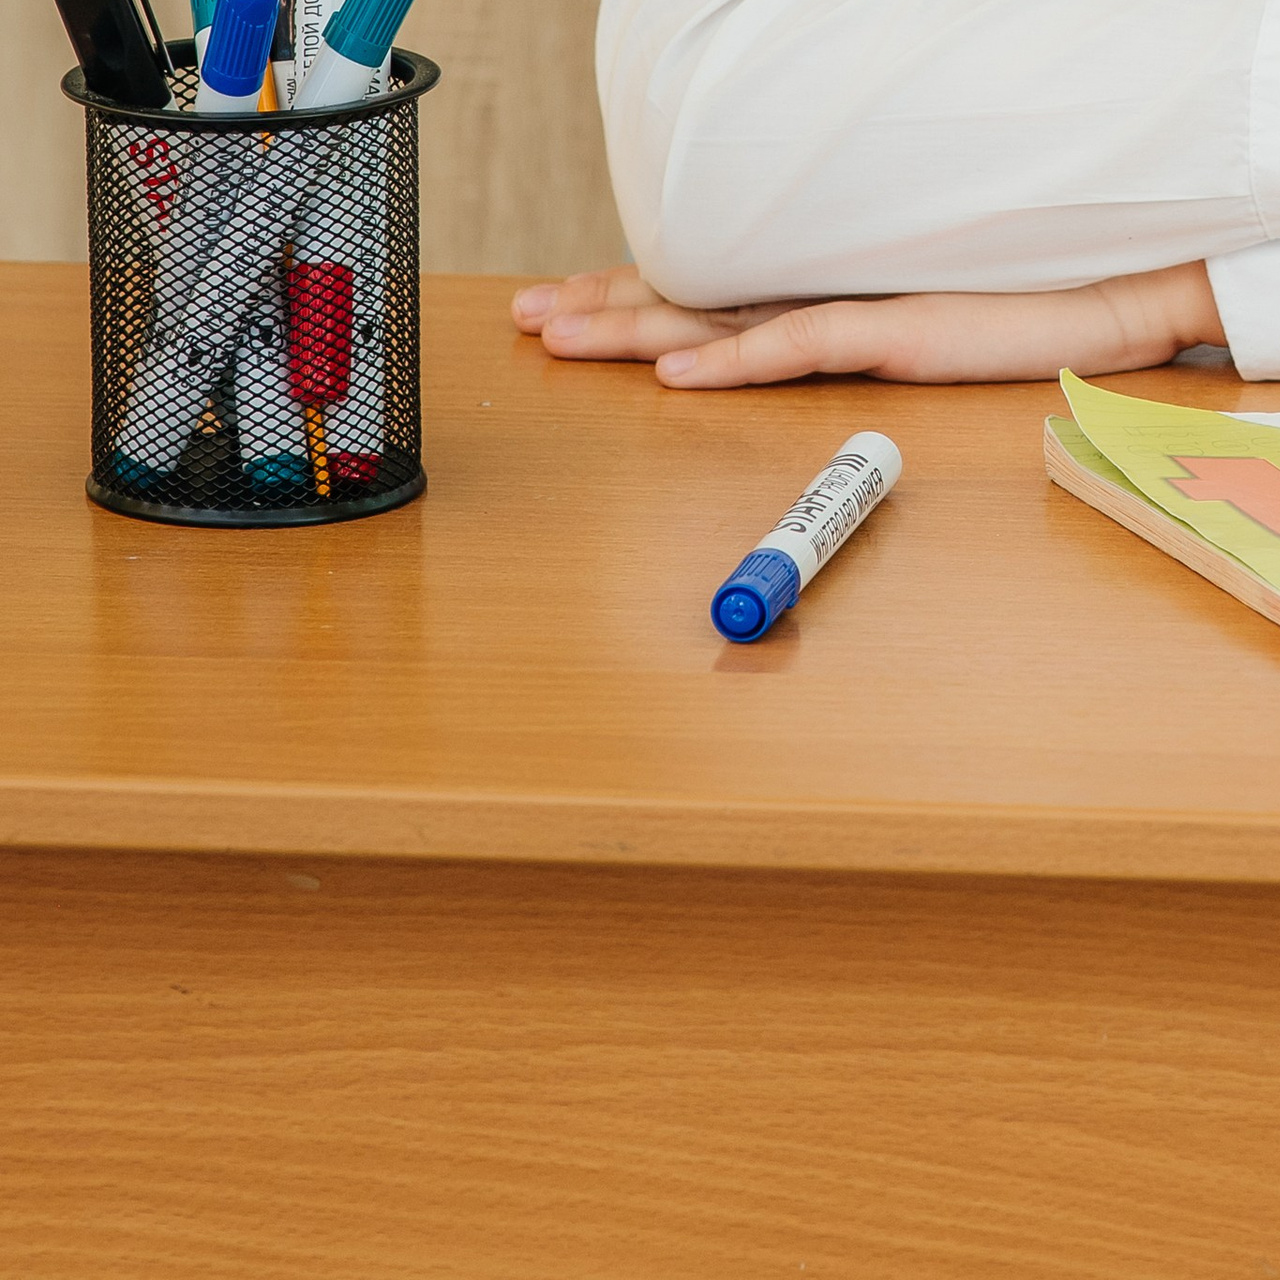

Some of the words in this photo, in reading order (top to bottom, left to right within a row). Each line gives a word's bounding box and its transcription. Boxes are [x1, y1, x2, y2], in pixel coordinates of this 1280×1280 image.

[769, 490, 833, 534] STAFF
[810, 498, 858, 565] WHITEBOARD
[852, 467, 885, 520] MARKER
